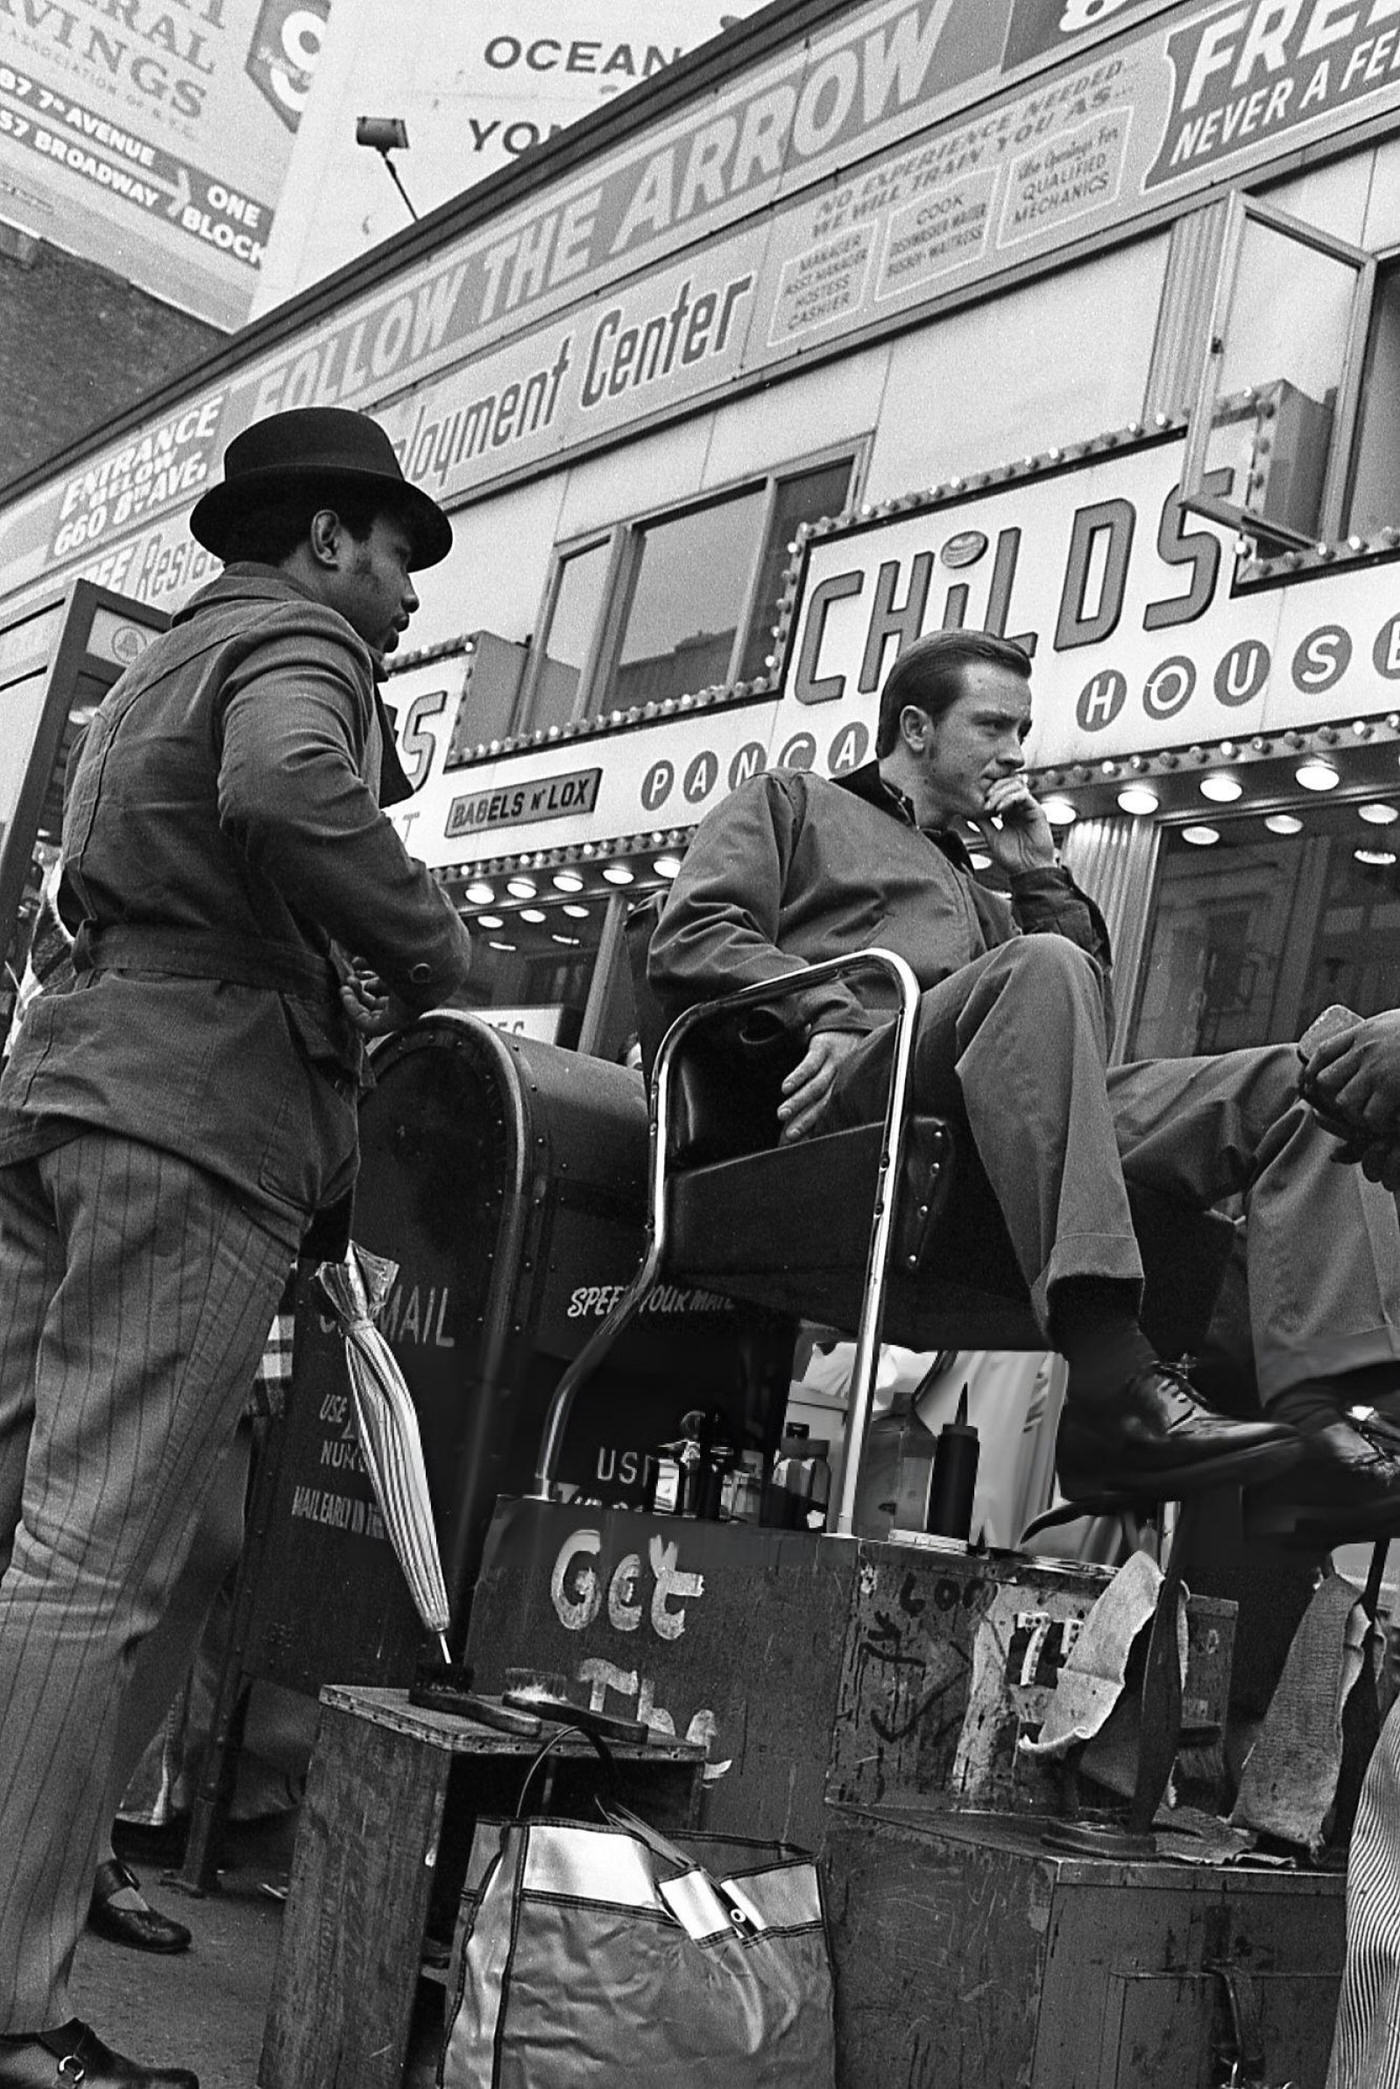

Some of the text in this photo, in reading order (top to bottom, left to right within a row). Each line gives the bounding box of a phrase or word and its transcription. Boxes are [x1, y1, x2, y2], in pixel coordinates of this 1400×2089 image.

[0, 0, 207, 118] VINGS
[80, 0, 217, 75] RAL
[484, 36, 683, 77] OCEAN
[1181, 0, 1400, 112] FRE
[1022, 60, 1123, 119] NEEDED
[1169, 78, 1295, 167] NEVER
[1299, 60, 1331, 110] A
[66, 107, 156, 167] AVENUE
[468, 119, 564, 155] YO
[911, 143, 986, 192] TRAIN
[997, 112, 1055, 152] YOU
[34, 130, 159, 207] BROADWAY
[1015, 171, 1109, 222] MECHANICS
[1023, 153, 1106, 200] QUALIFIED
[207, 184, 262, 229] ONE
[253, 0, 951, 415] FOLLOW THE ARROW
[916, 194, 965, 225] COOK
[393, 274, 752, 487] loyment Center
[60, 396, 223, 520] ENTRANCE
[54, 506, 107, 556] 660
[550, 778, 590, 809] LOX
[378, 1283, 455, 1347] MAIL
[690, 1289, 736, 1312] MAIL
[319, 1394, 348, 1423] USE
[321, 1440, 366, 1474] NUM
[291, 1485, 320, 1521] MAIL
[318, 1491, 351, 1530] EARLY
[551, 1529, 705, 1640] Get
